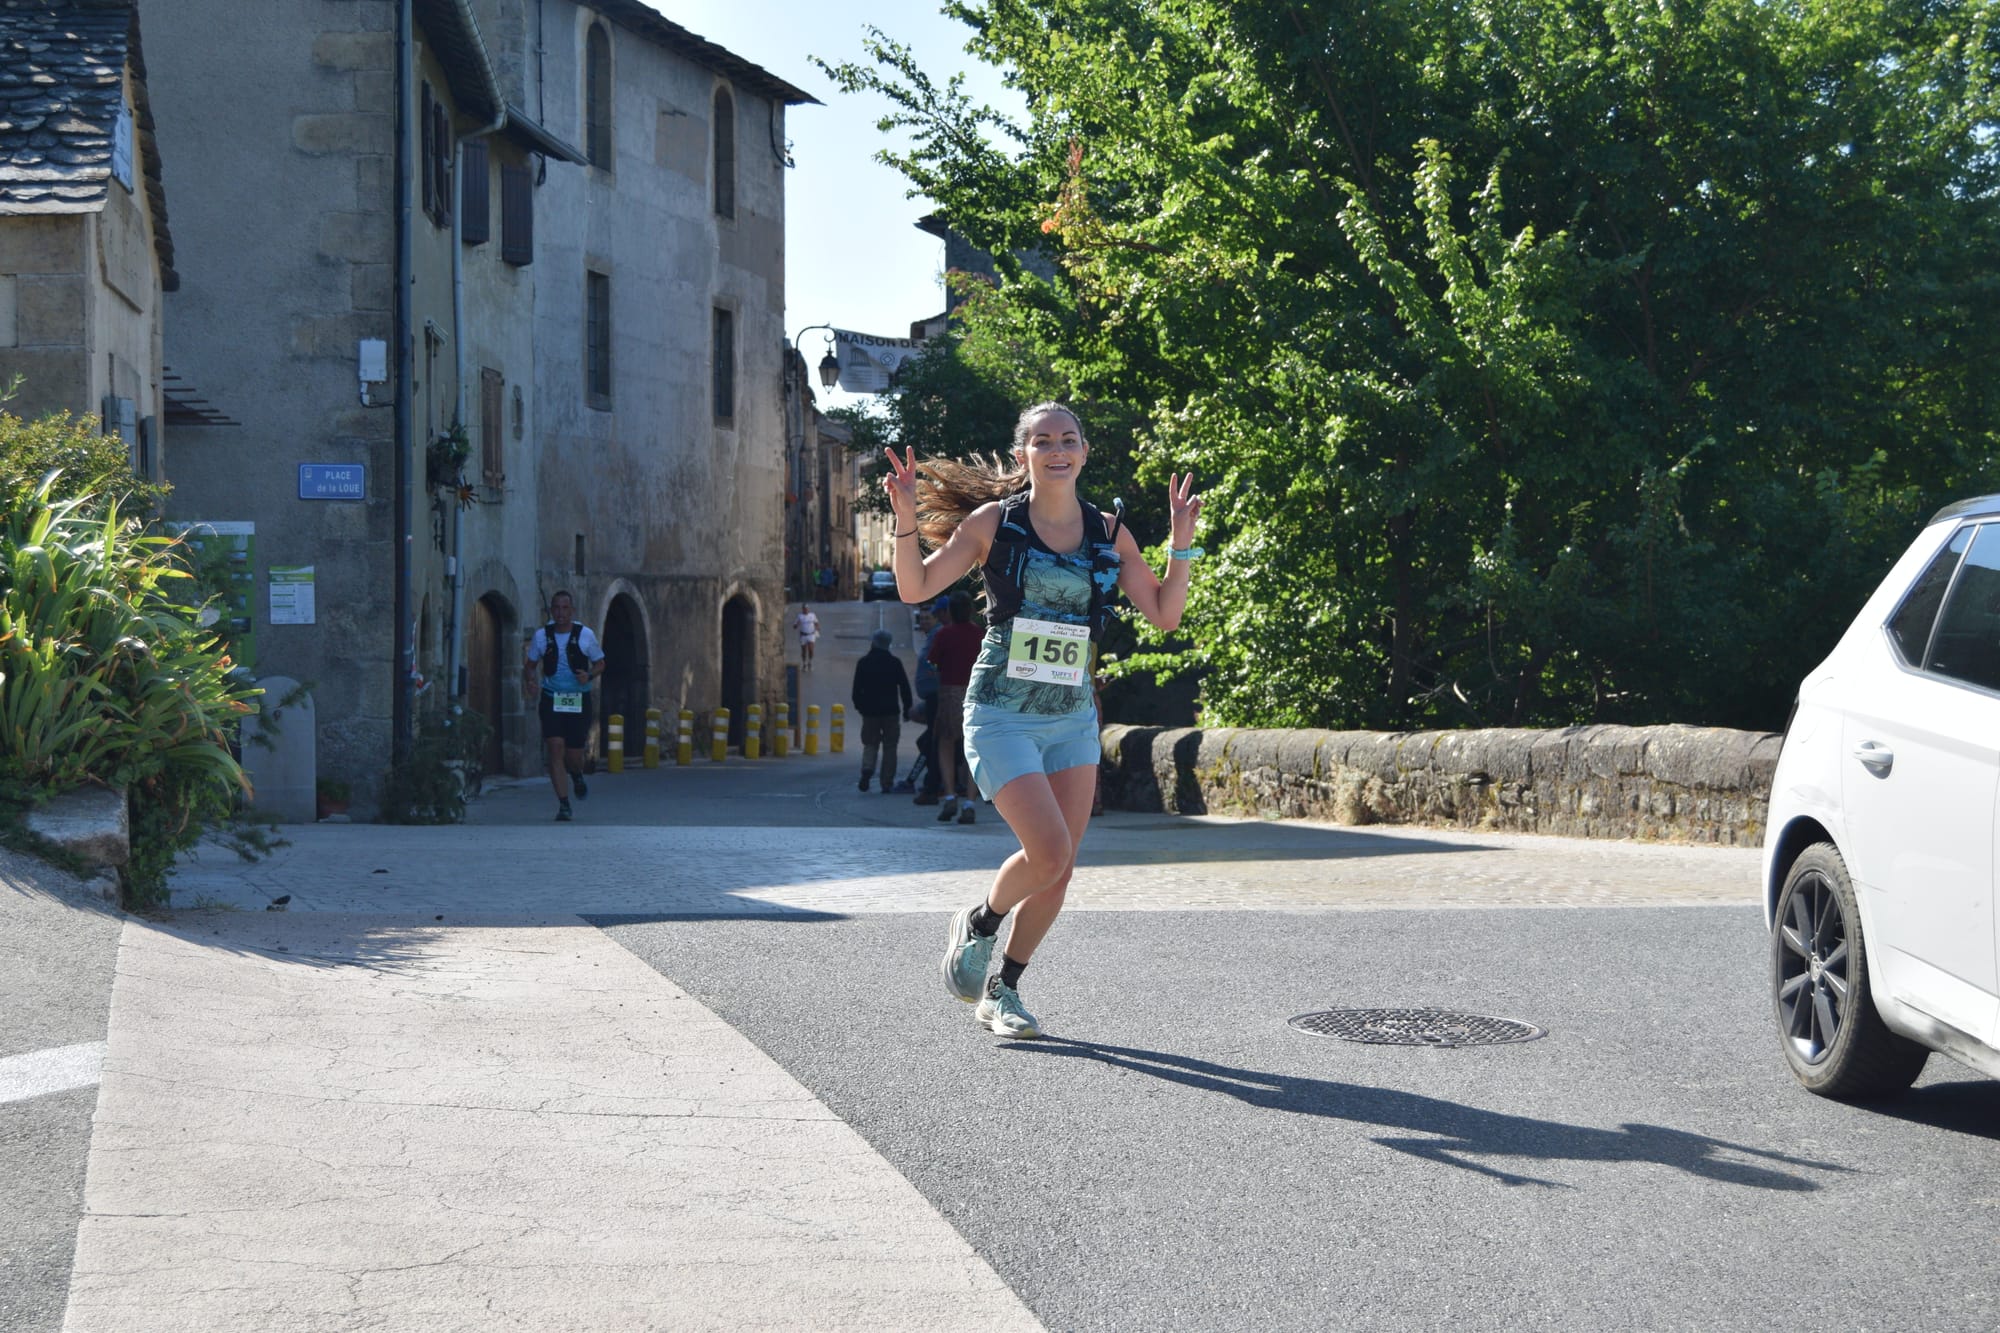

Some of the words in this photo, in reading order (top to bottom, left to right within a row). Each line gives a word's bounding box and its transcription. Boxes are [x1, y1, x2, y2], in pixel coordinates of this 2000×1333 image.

[839, 332, 896, 347] MAISON
[901, 339, 919, 349] DE
[325, 471, 352, 480] PLACE
[317, 483, 327, 493] de
[329, 483, 337, 493] la
[339, 483, 360, 493] LOUE
[1024, 636, 1079, 666] 156
[561, 697, 575, 706] 55
